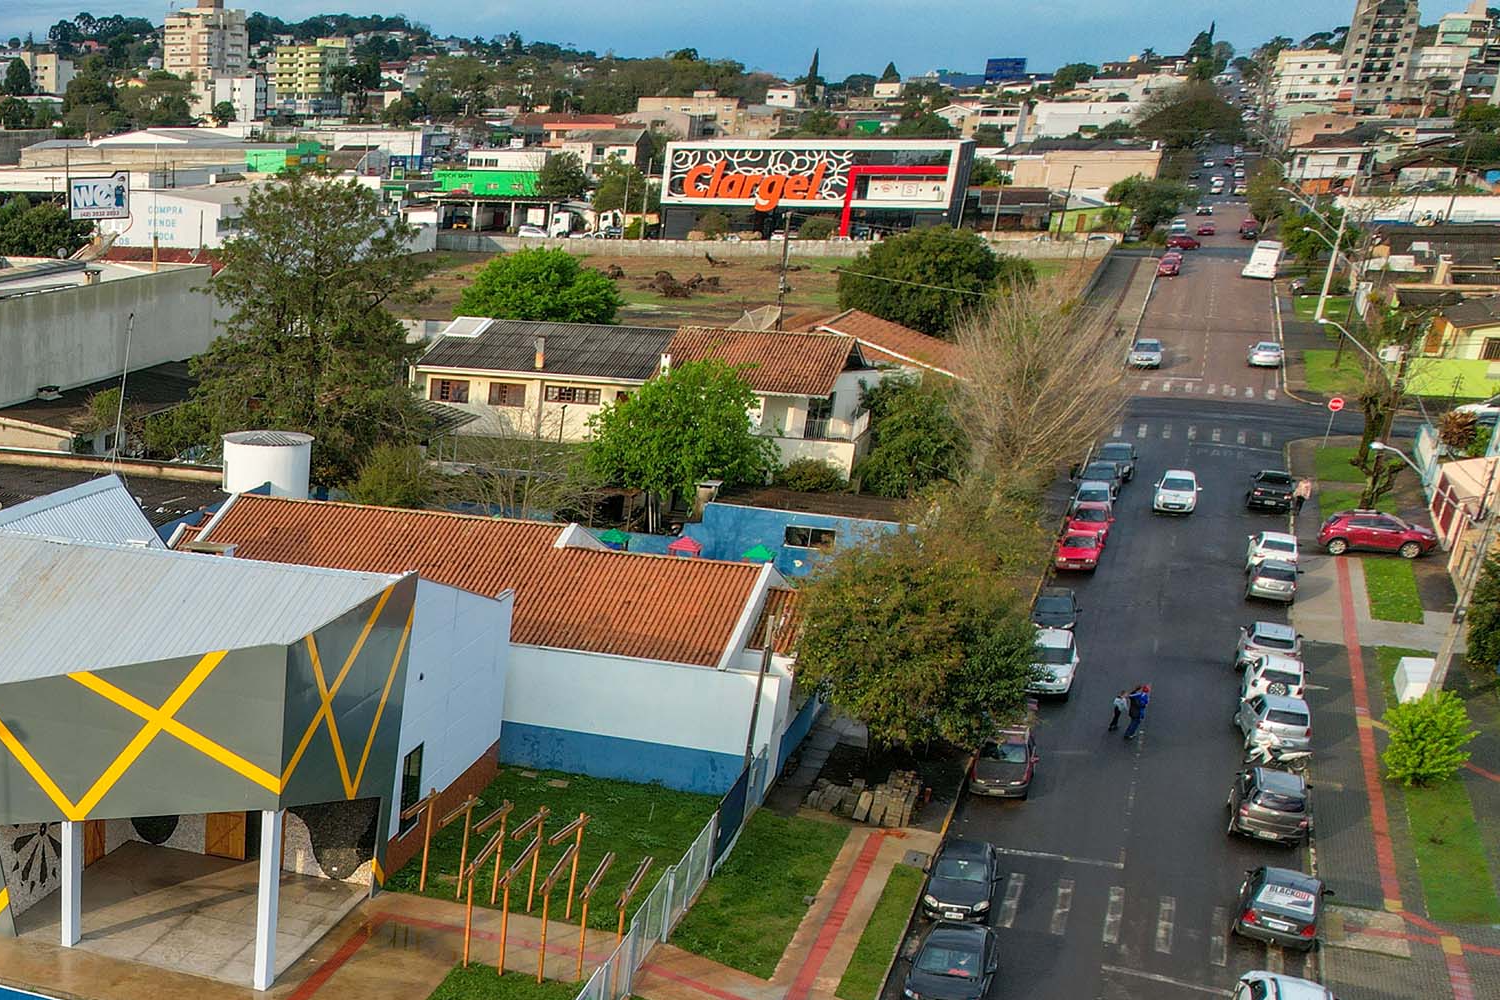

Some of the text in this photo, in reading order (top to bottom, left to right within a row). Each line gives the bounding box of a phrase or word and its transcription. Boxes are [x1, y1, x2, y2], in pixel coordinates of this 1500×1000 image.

[684, 161, 828, 212] Clargel
[147, 206, 183, 215] COMPRA
[147, 219, 177, 228] VENDE
[1269, 885, 1310, 900] BLACKOUT
